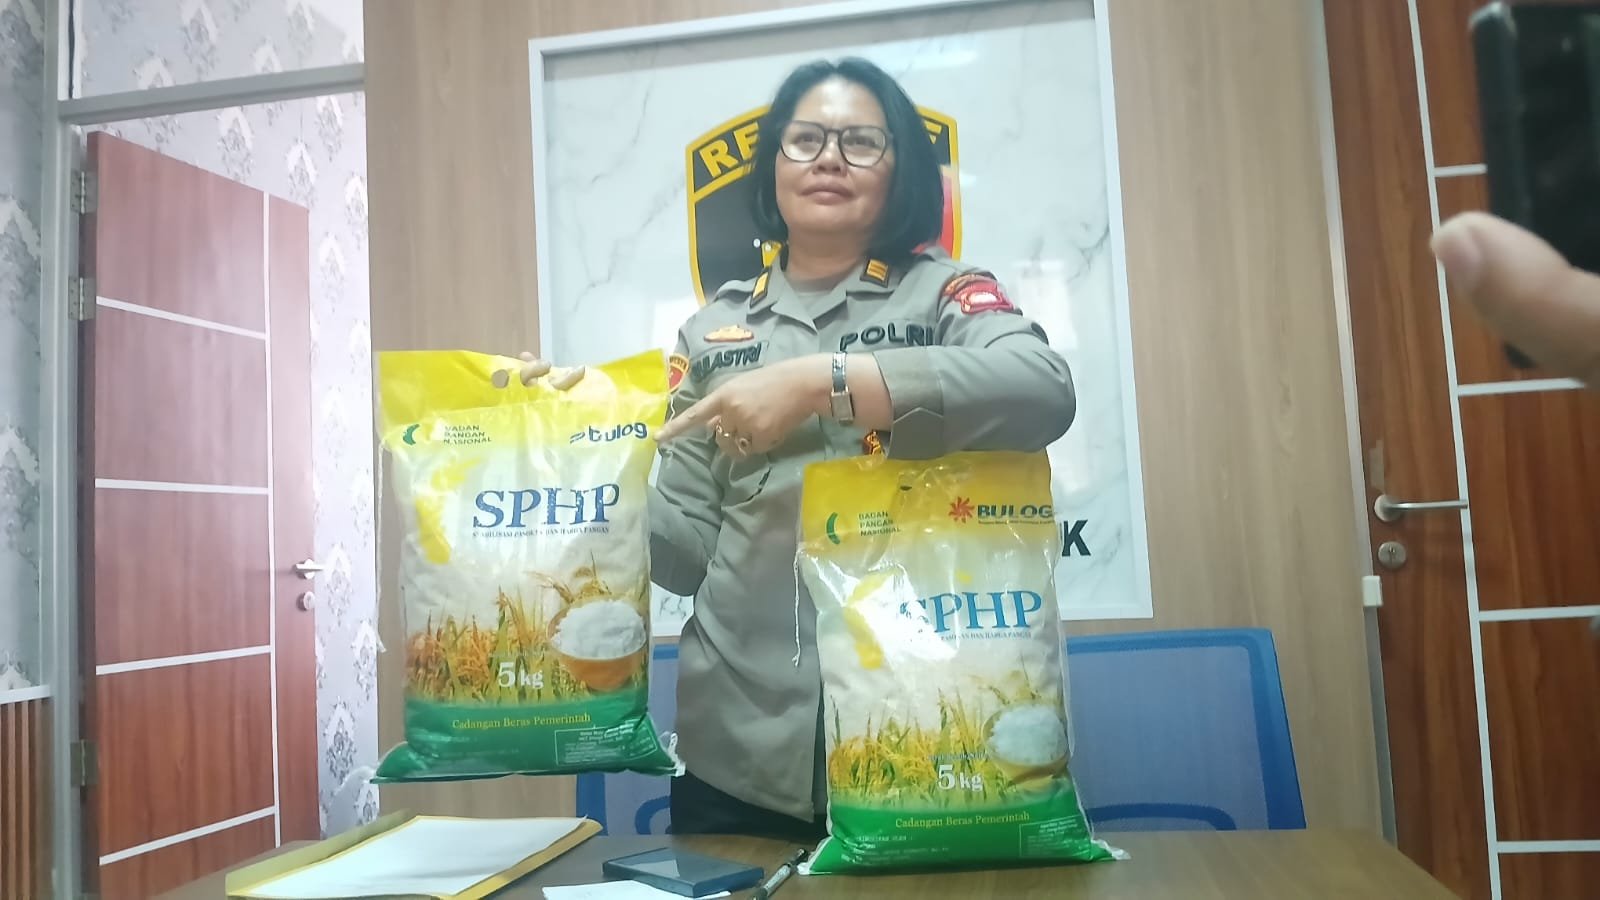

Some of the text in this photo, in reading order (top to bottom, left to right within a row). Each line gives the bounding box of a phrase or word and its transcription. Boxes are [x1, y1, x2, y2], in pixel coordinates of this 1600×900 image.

[839, 324, 933, 352] POLRI
[473, 483, 620, 528] SPHP
[977, 504, 1053, 518] BULOG
[900, 590, 1042, 632] PHP
[498, 662, 544, 690] 5 kg
[452, 712, 591, 730] Cadangan Beras Pemerintah
[938, 764, 983, 792] 5 kg
[895, 811, 1030, 828] Cadangan Beras Pemerintah
